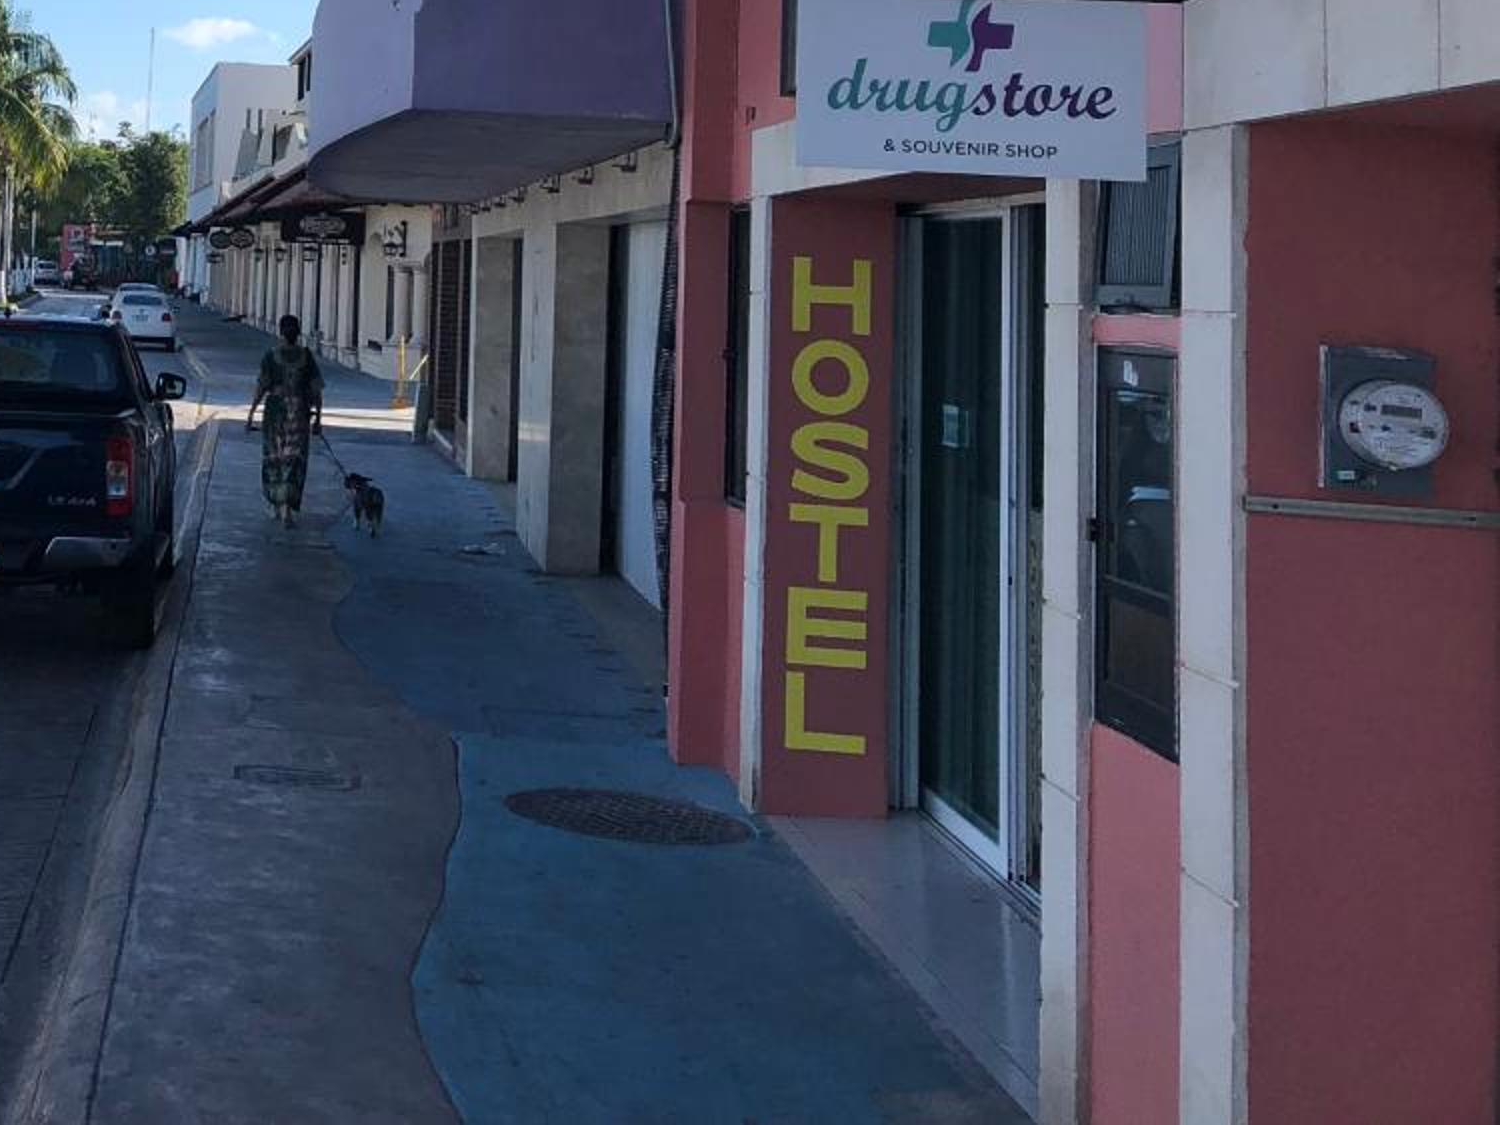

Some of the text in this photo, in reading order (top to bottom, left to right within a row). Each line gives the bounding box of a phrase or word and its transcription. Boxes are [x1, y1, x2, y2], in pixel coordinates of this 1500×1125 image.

[827, 58, 1117, 133] drugstore
[883, 138, 1059, 160] & SOUVENIR SHOP
[785, 257, 872, 755] HOSTEL
